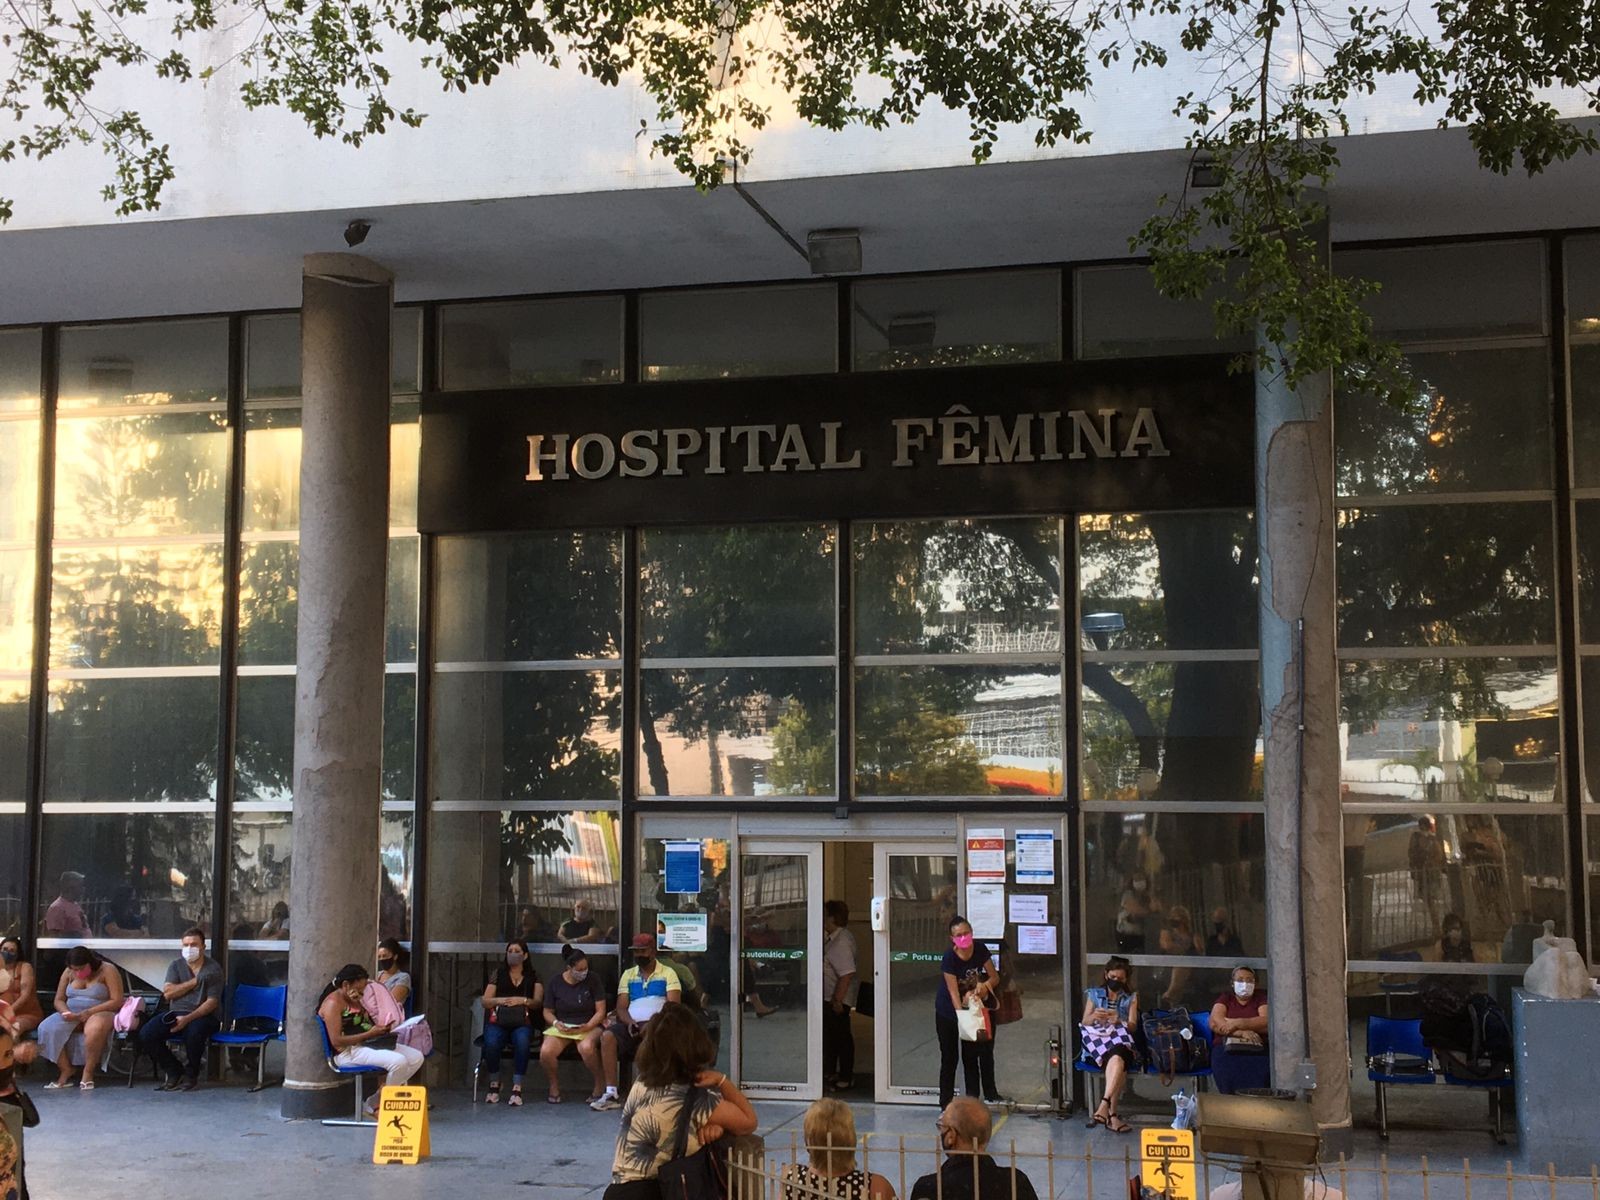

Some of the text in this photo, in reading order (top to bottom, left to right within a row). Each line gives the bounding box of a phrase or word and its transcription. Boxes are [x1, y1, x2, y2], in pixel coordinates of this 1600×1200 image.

[525, 403, 1170, 481] HOSPITAL FÊMINA
[746, 951, 786, 959] automática
[385, 1101, 420, 1110] CUIDADO
